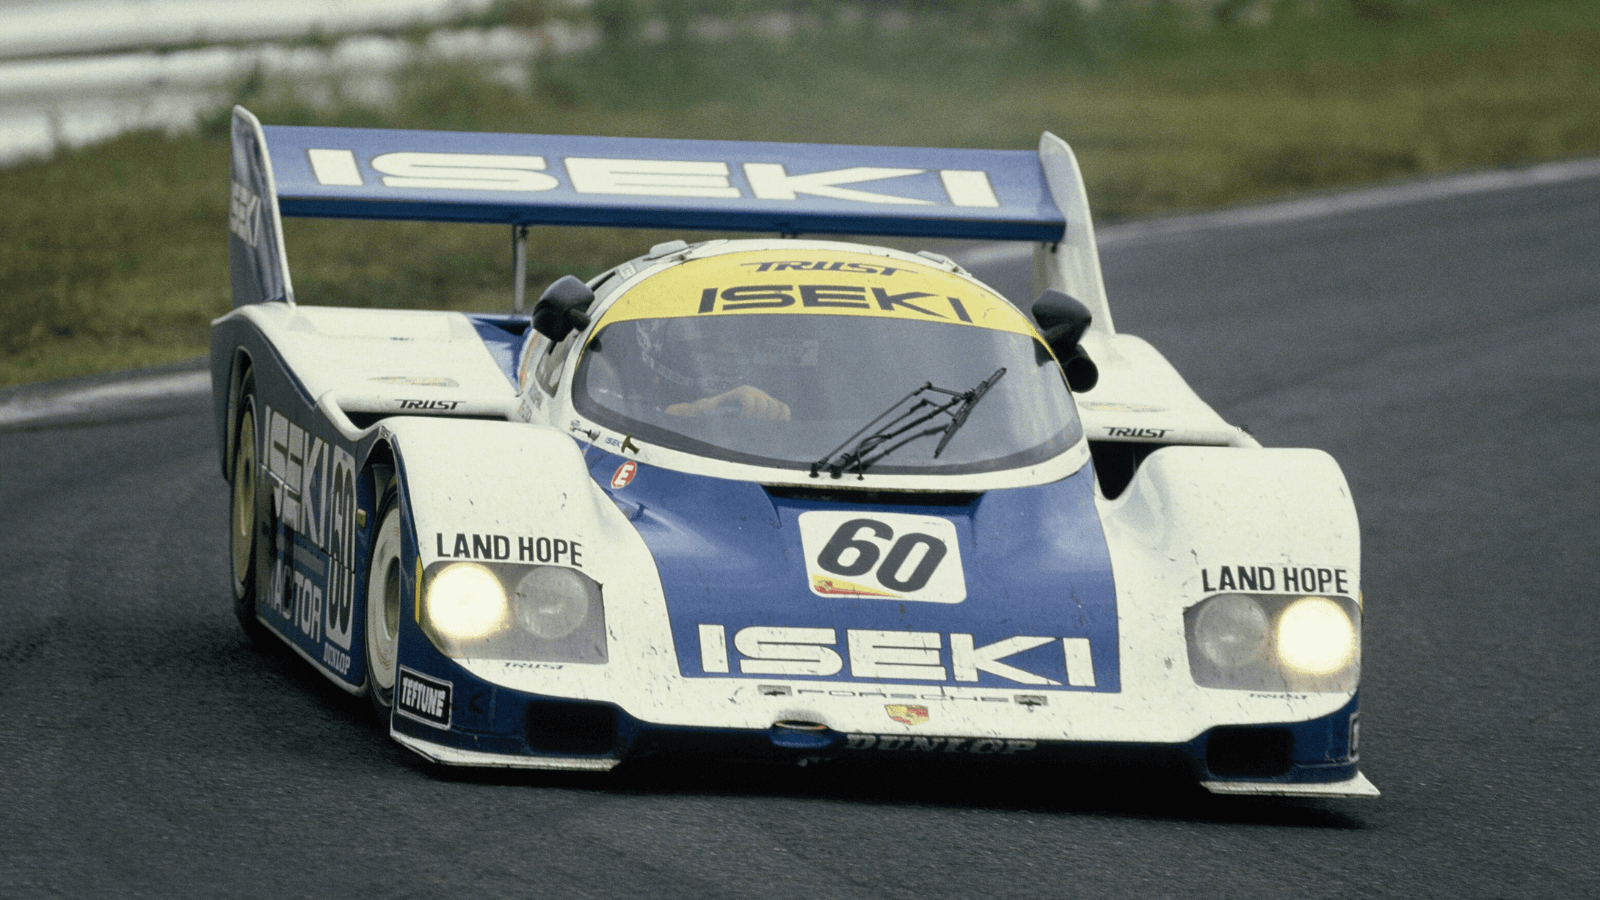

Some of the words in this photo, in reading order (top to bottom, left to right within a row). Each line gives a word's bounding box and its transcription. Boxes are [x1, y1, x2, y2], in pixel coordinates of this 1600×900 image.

[306, 148, 1000, 208] ISEKI
[740, 259, 919, 277] TRUST
[698, 284, 974, 324] ISEKI
[394, 398, 467, 410] TRUST
[1102, 426, 1174, 438] TRUST
[436, 532, 511, 560] LAND
[518, 536, 583, 568] HOPE
[816, 517, 948, 593] 60
[1201, 565, 1275, 592] LAND
[1283, 567, 1349, 594] HOPE
[698, 624, 1097, 687] ISEKI
[846, 734, 1038, 754] DUNLOP
